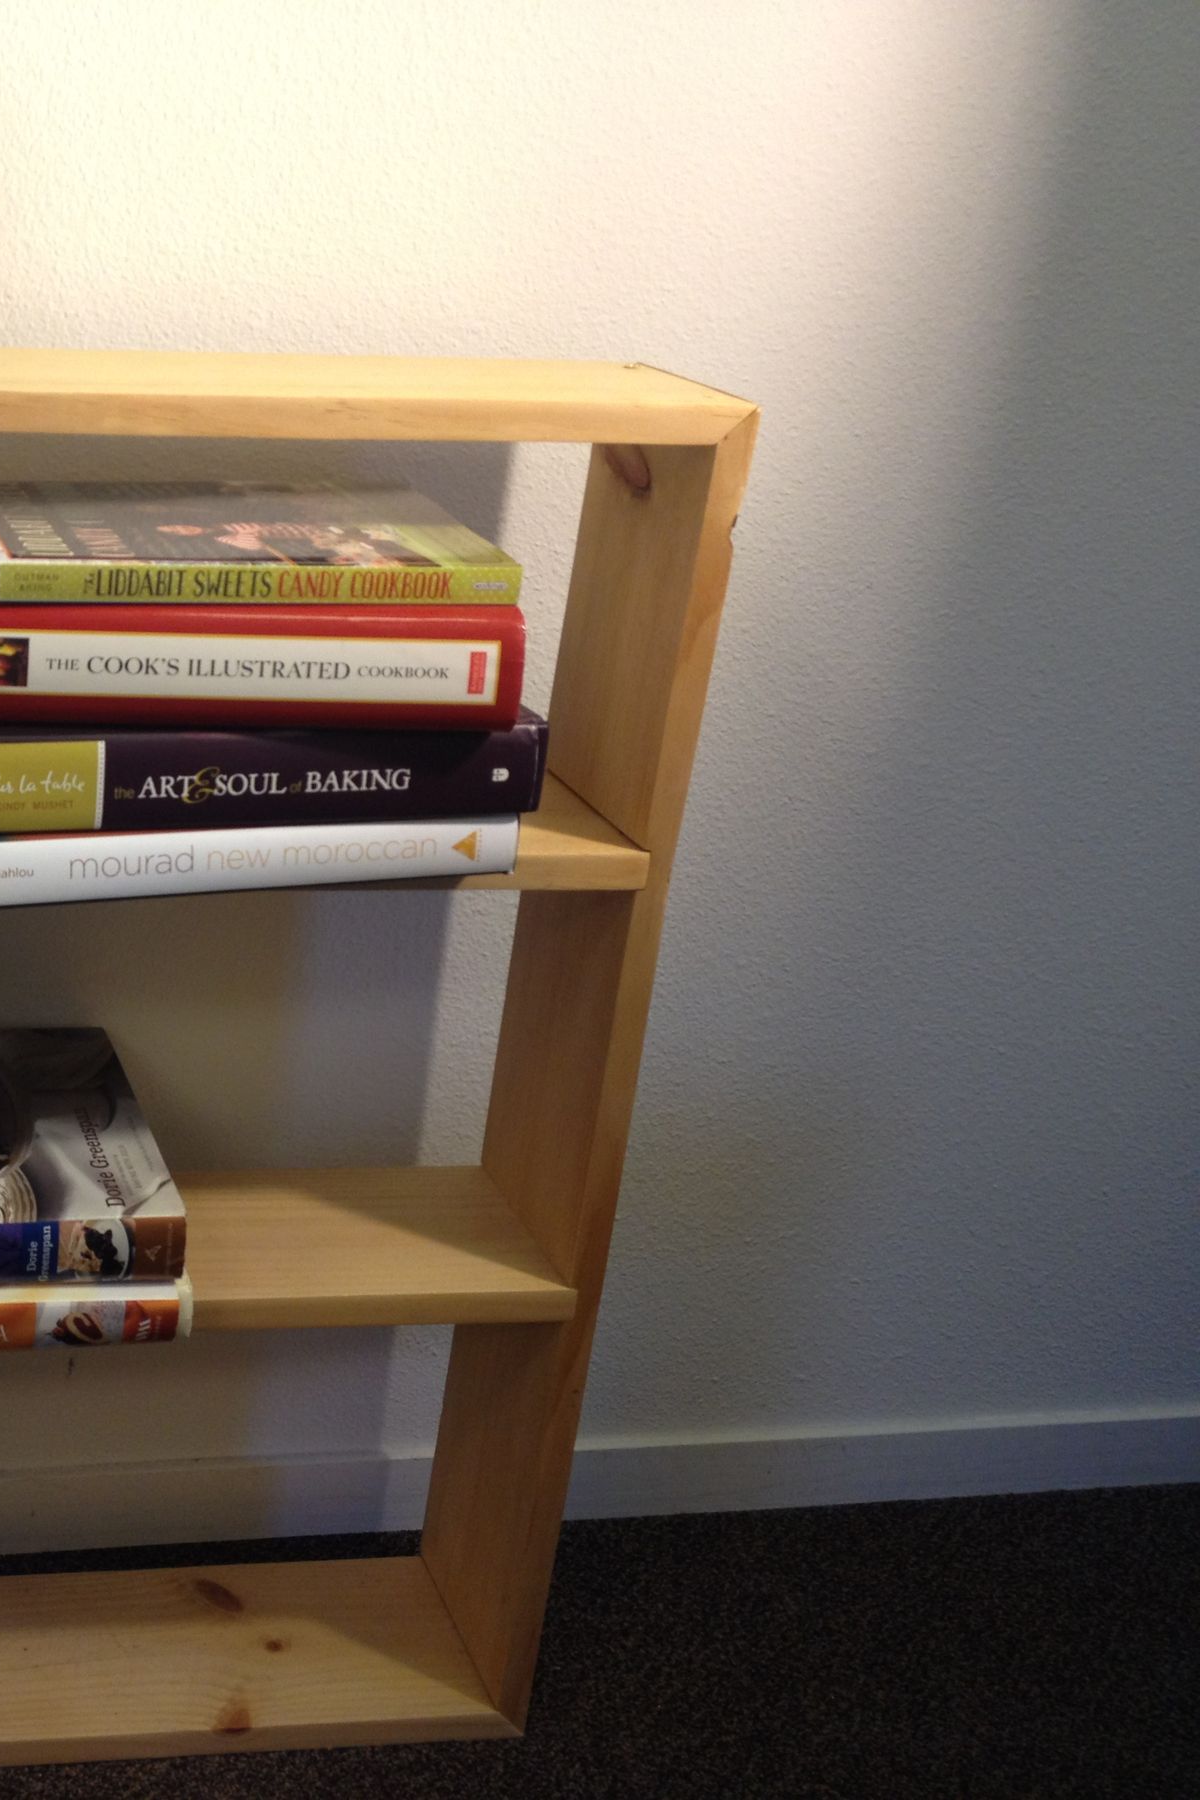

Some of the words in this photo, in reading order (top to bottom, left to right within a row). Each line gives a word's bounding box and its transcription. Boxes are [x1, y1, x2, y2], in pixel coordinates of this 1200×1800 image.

[96, 568, 187, 597] LIDDABIT
[193, 570, 273, 599] SWEETS
[278, 570, 345, 599] CANDY
[350, 571, 455, 600] COOKBOOK
[45, 657, 80, 671] THE
[87, 656, 179, 677] COOK'S
[187, 657, 351, 680] ILLUSTRATED
[357, 664, 450, 680] COOKBOOK
[19, 773, 37, 793] la
[39, 770, 87, 794] table
[113, 786, 135, 800] the
[138, 775, 198, 799] ART
[181, 766, 222, 804] &
[213, 772, 288, 797] SOUL
[305, 768, 412, 793] BAKING
[68, 845, 195, 881] mourad
[207, 847, 271, 872] new
[282, 836, 439, 868] moroccan
[74, 1106, 108, 1170] Greenspan
[96, 1170, 127, 1208] Dorie
[26, 1240, 39, 1273] Dorie
[37, 1225, 53, 1283] Greenspan
